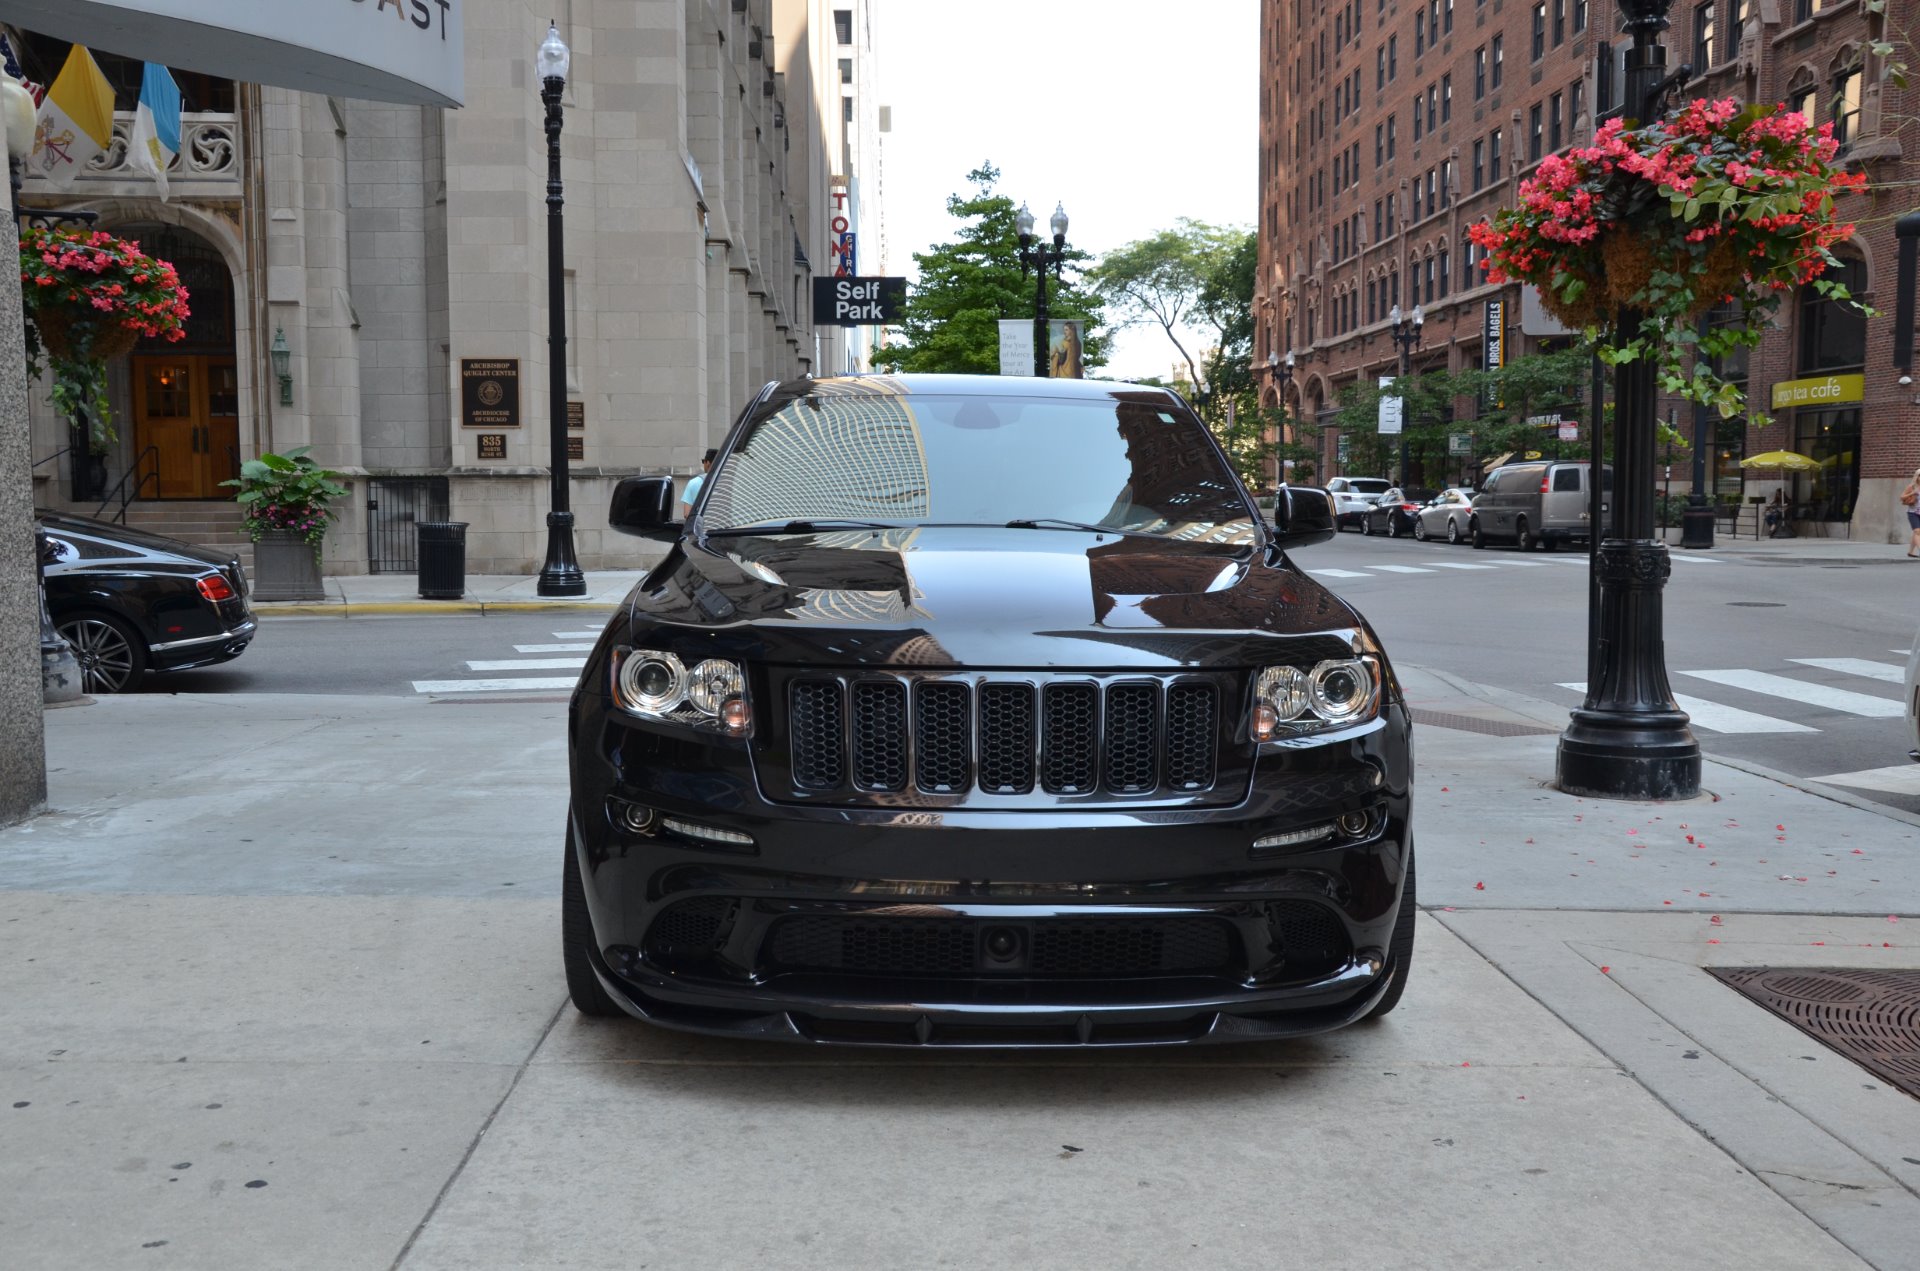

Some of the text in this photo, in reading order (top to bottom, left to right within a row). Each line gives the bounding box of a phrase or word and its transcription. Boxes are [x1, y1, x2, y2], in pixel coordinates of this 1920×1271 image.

[836, 281, 880, 300] Self
[836, 301, 883, 319] Park
[1489, 302, 1501, 337] BAGELS
[1010, 351, 1030, 360] Mercy
[1489, 339, 1500, 364] BROS.
[1793, 386, 1808, 400] tea
[1810, 377, 1841, 398] café
[482, 435, 501, 447] 835
